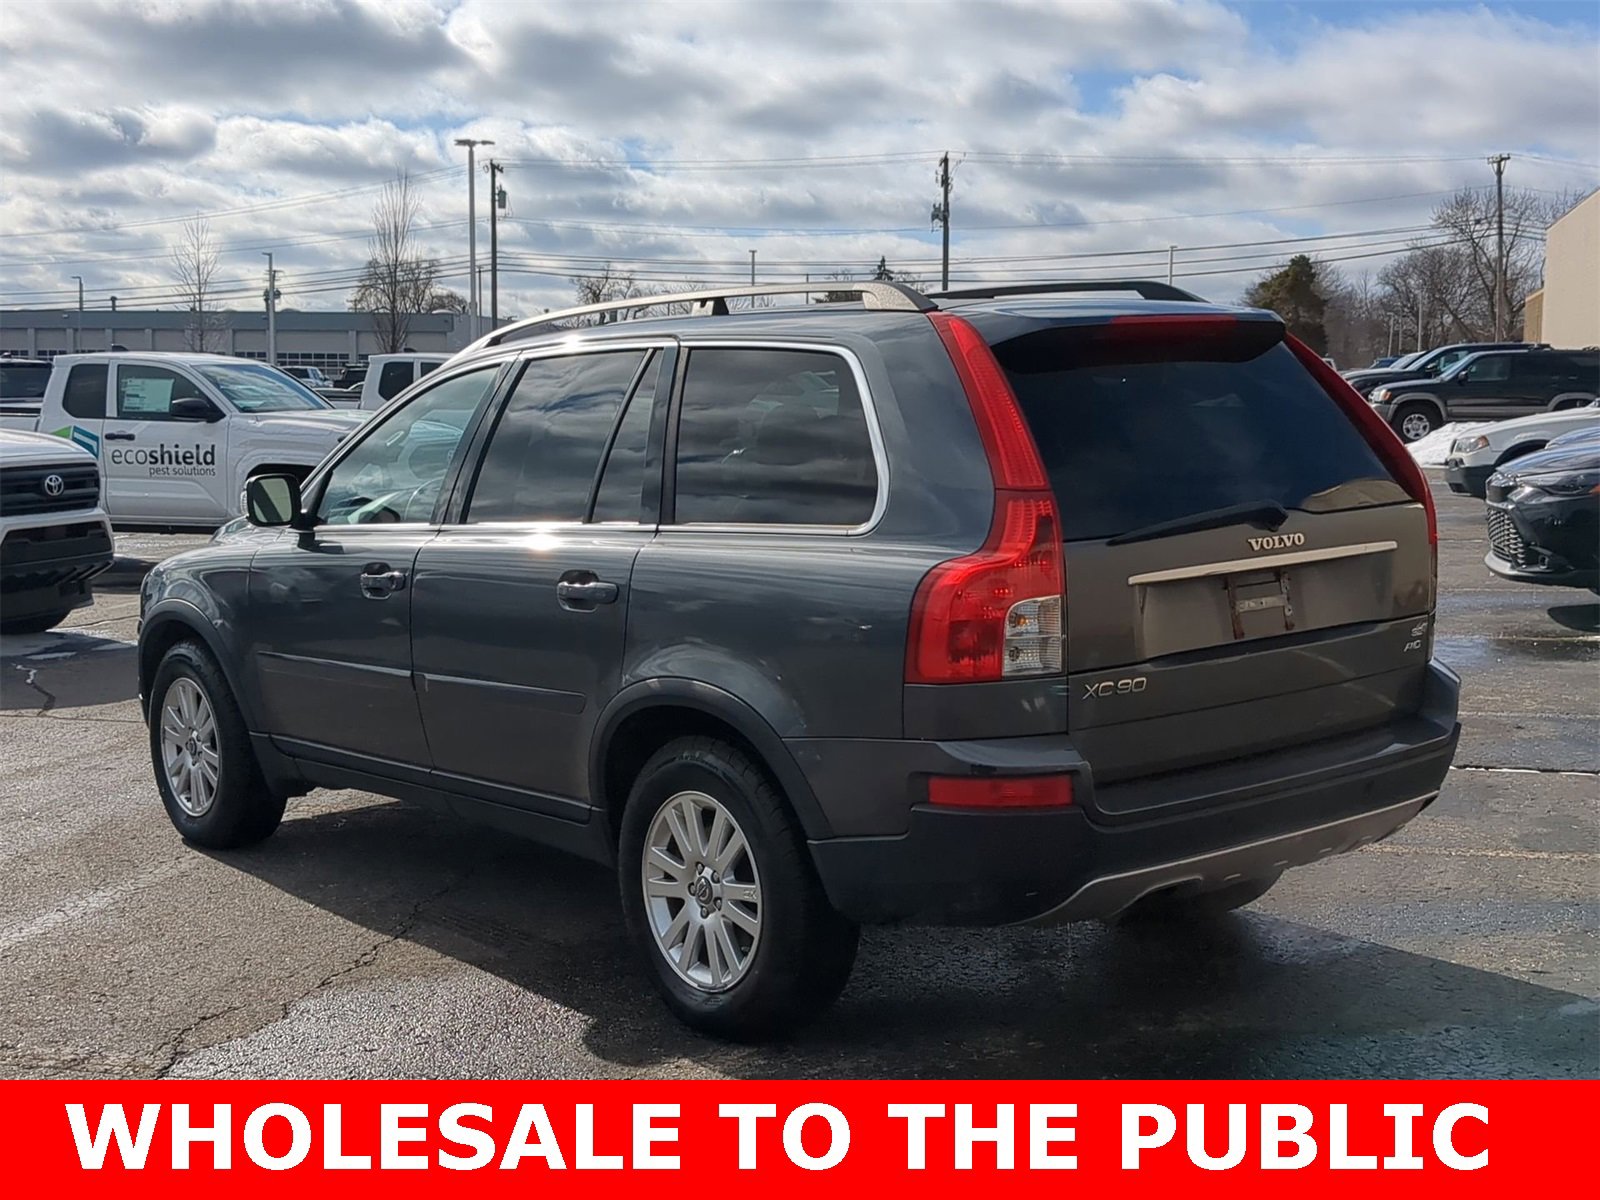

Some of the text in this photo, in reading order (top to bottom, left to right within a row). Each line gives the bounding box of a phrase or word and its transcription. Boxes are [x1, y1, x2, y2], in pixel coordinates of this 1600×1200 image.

[111, 443, 216, 466] ecoshield
[148, 466, 216, 477] pest solutions
[1247, 532, 1305, 551] VOLVO
[1082, 677, 1147, 700] XC90
